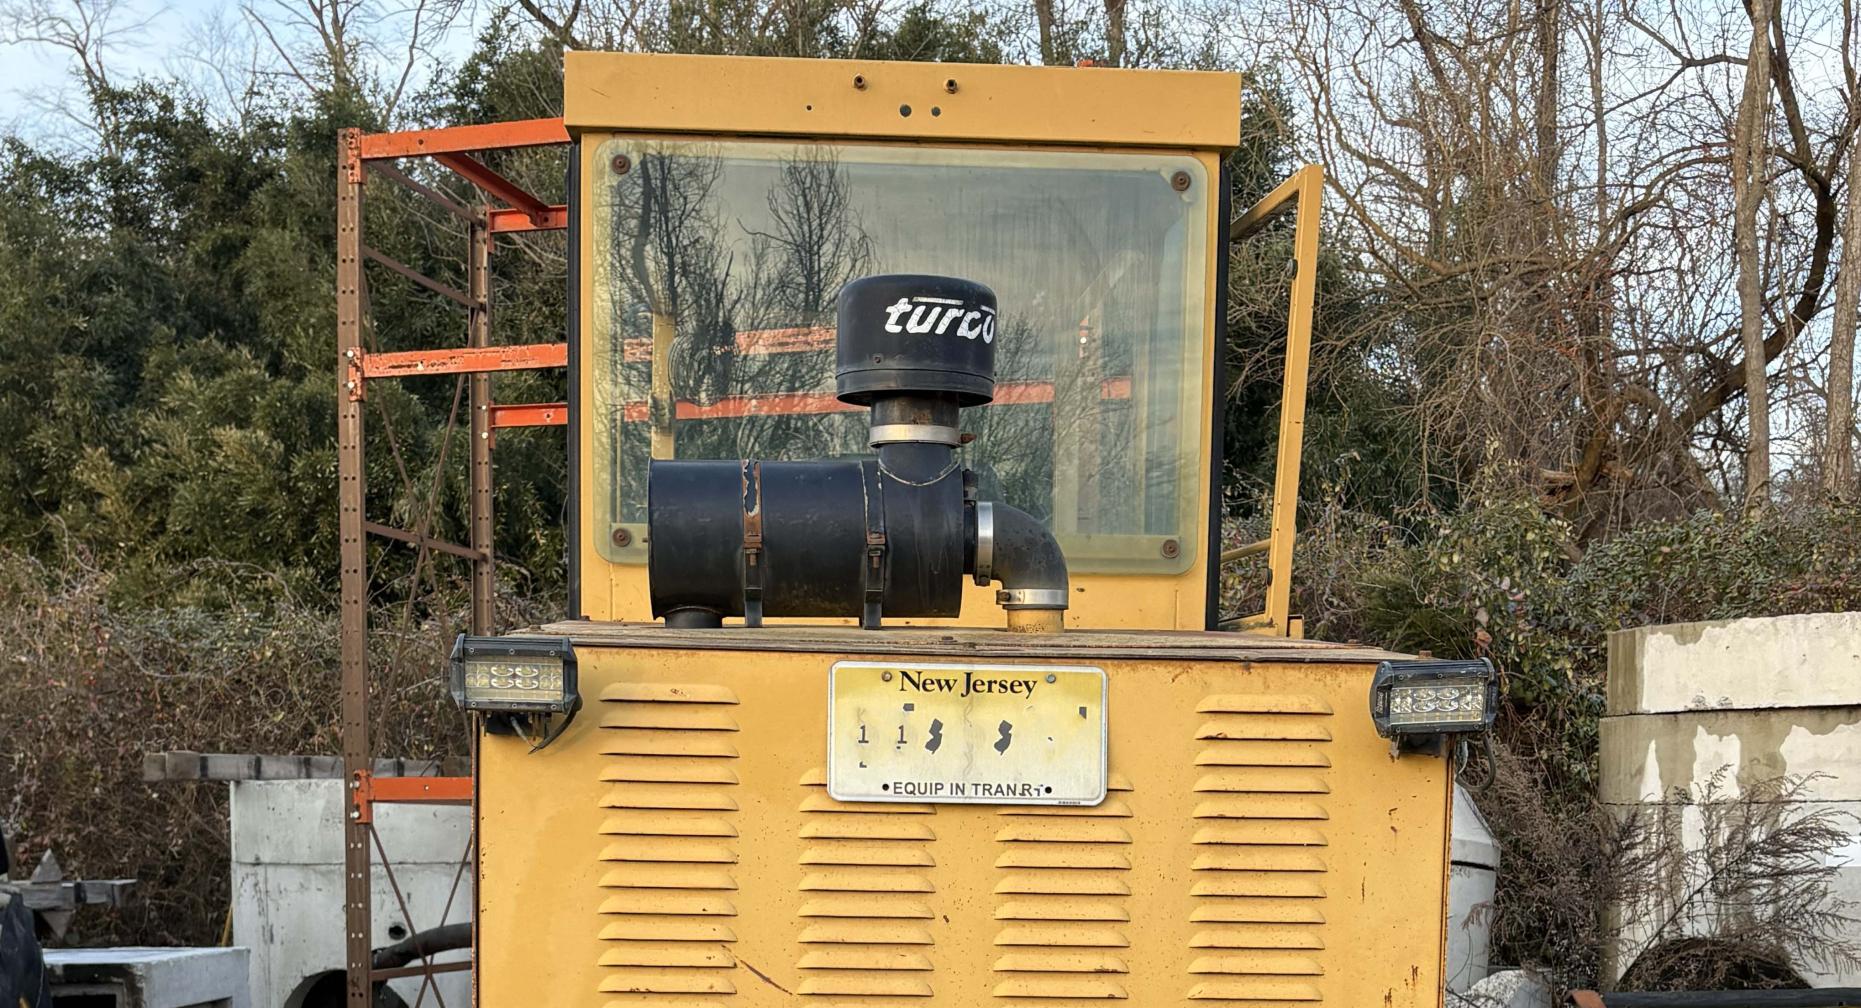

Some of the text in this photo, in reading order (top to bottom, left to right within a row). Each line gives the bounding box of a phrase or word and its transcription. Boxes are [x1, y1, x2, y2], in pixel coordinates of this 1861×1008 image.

[899, 671, 1038, 699] New Jersey
[893, 782, 945, 797] EQUIP
[950, 783, 966, 796] IN
